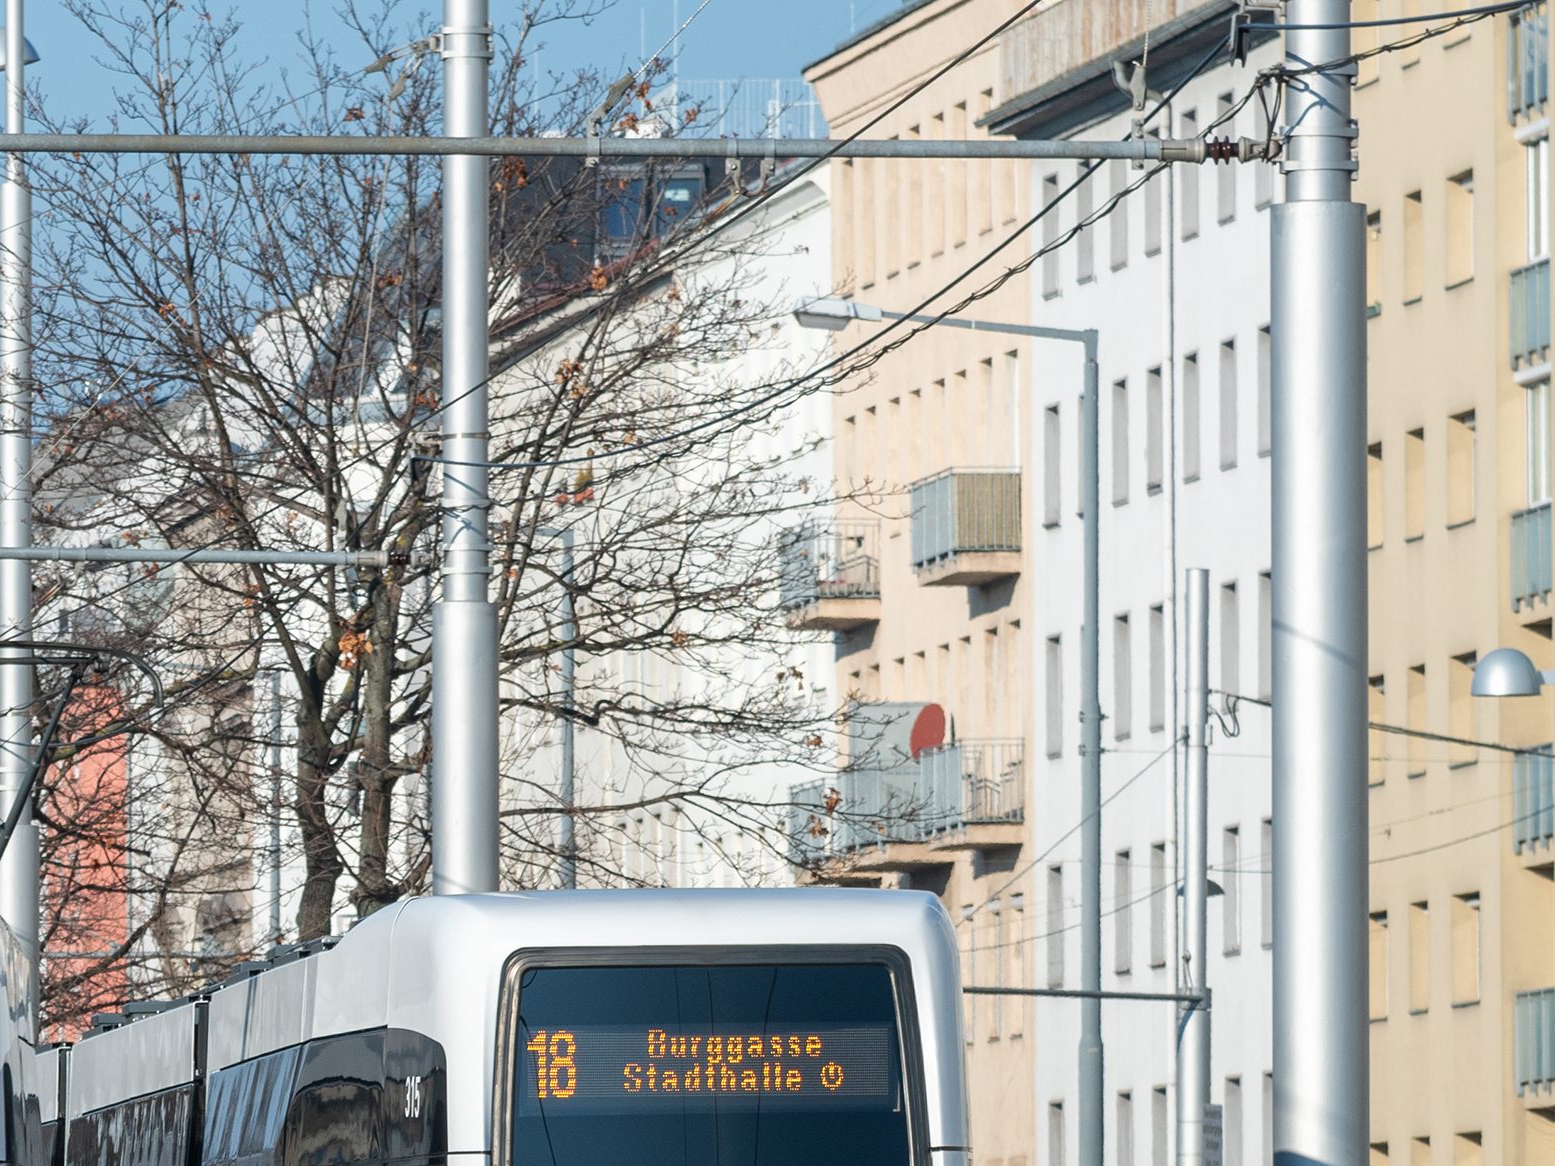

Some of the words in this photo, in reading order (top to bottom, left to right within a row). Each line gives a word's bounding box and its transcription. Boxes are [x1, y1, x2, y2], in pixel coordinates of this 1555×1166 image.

[527, 1030, 577, 1099] 18
[647, 1029, 823, 1063] Burggasse
[622, 1062, 804, 1092] Stadthalle
[404, 1075, 421, 1118] 315
